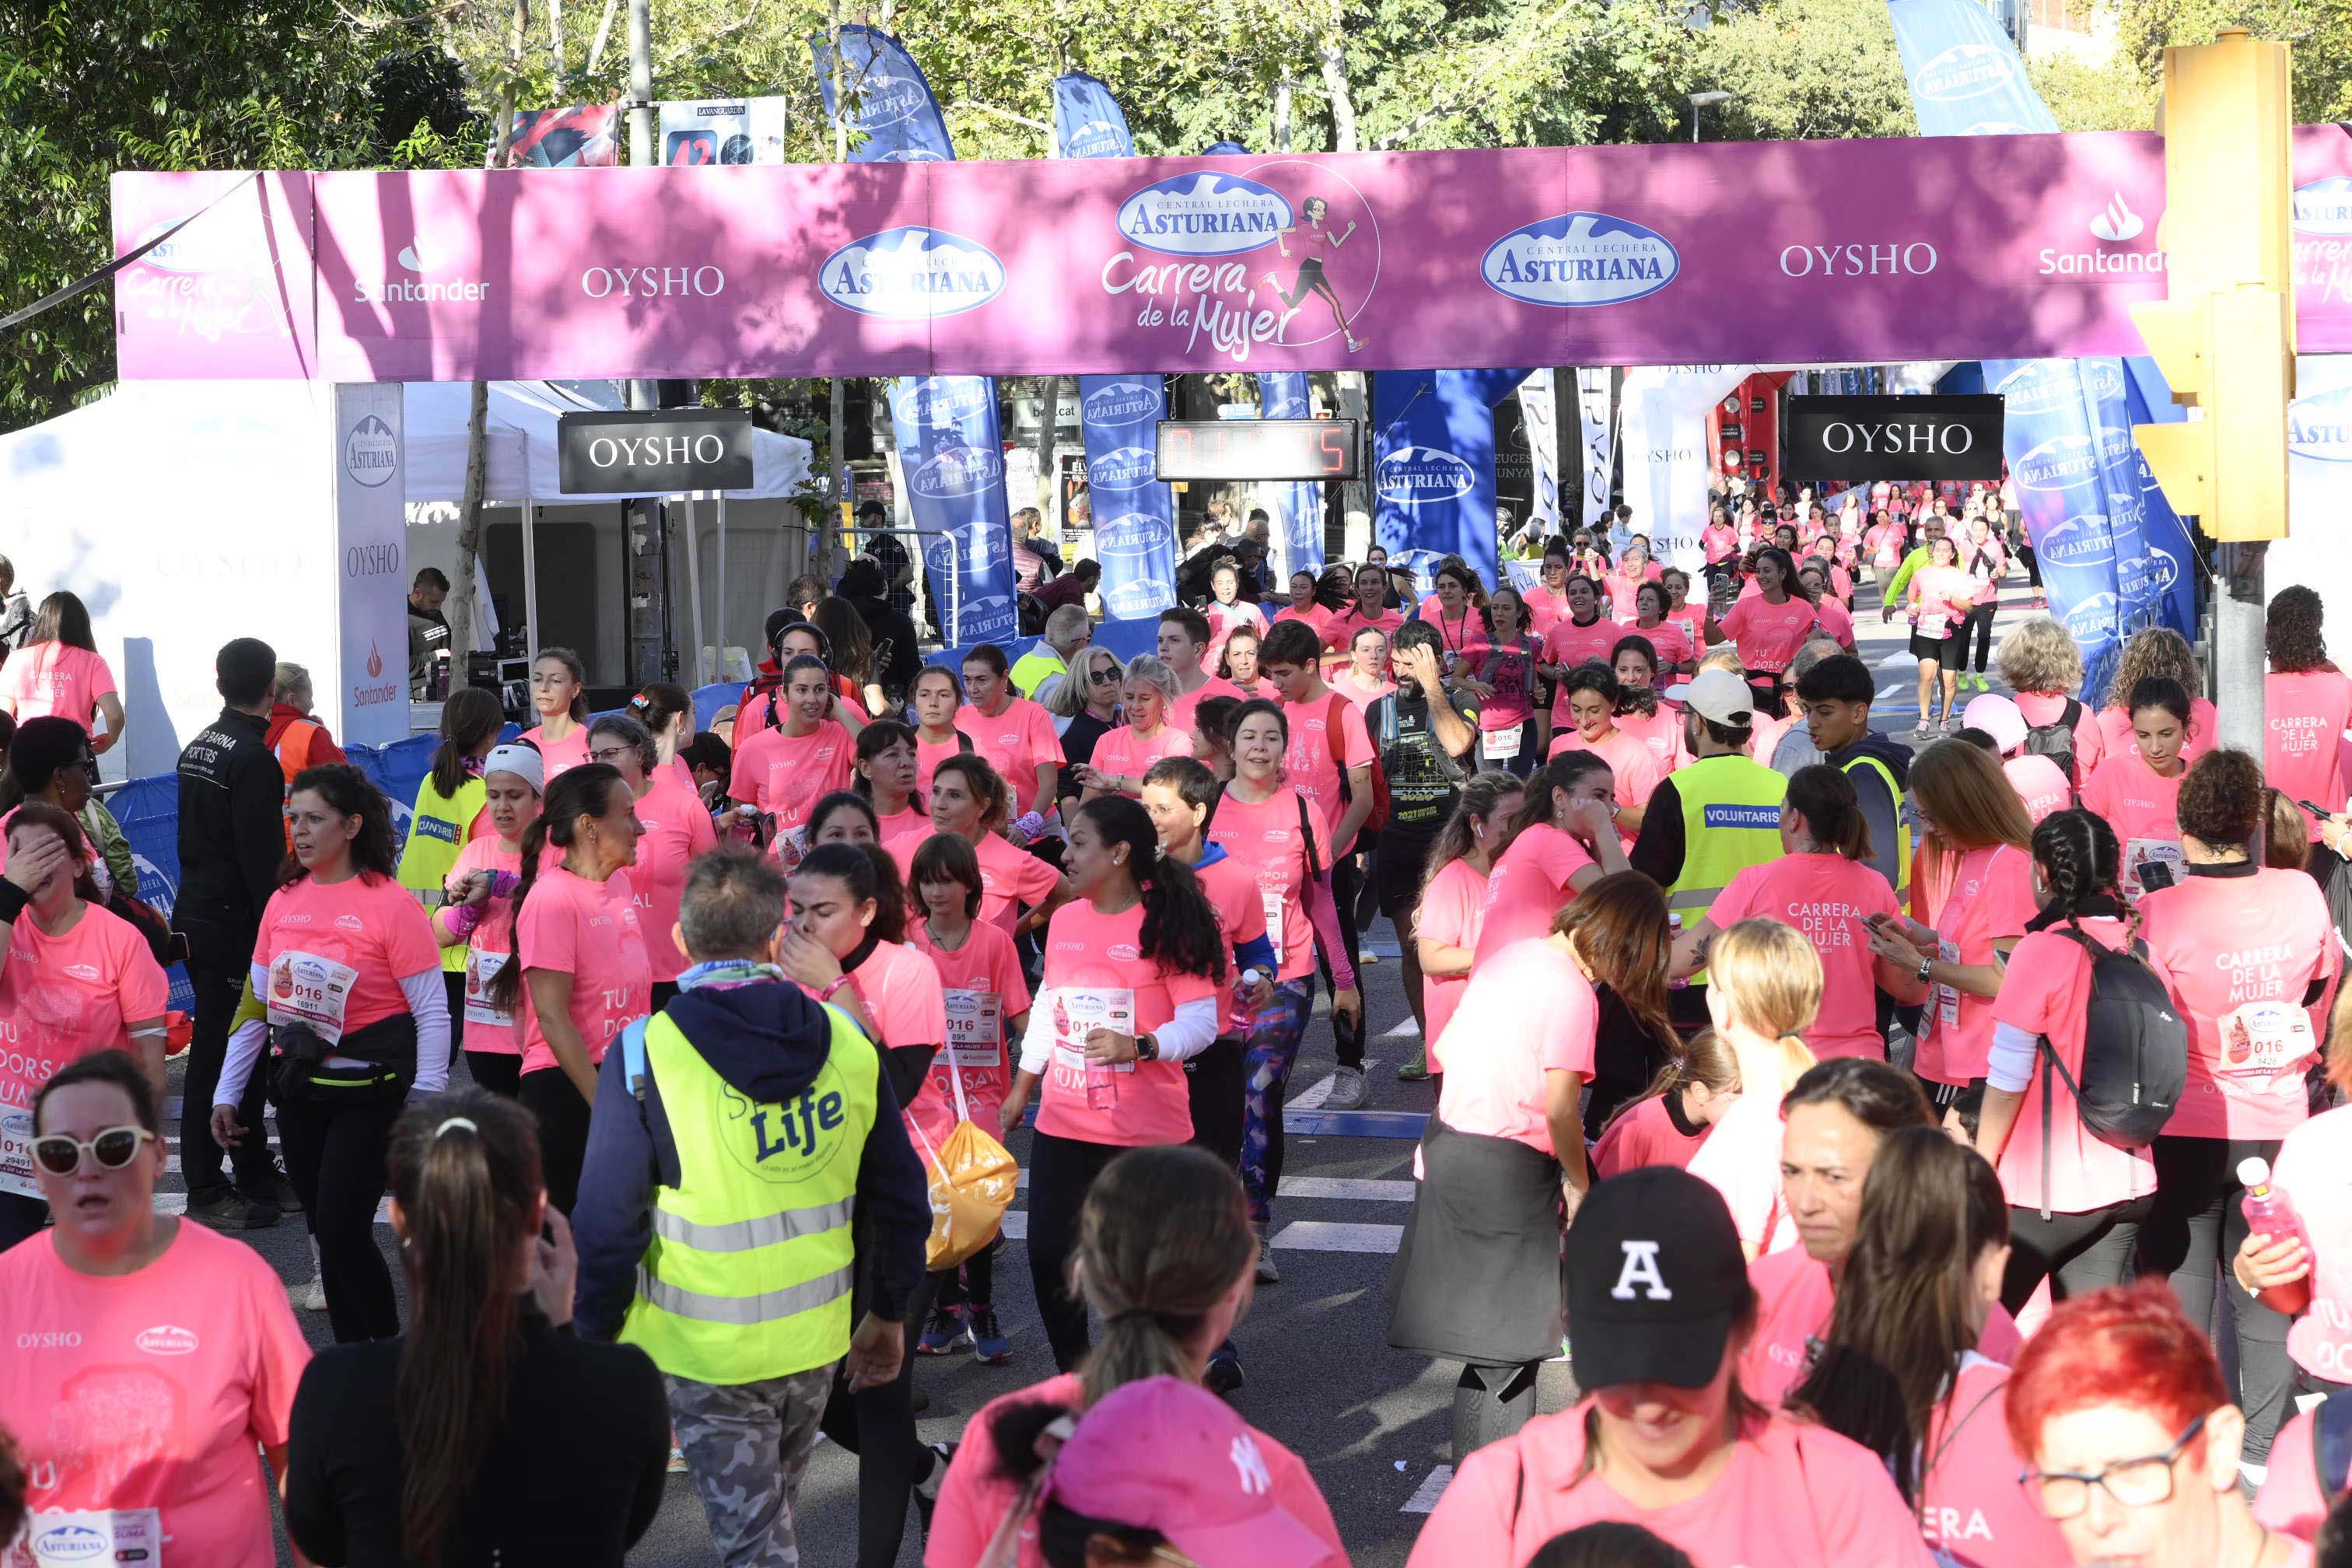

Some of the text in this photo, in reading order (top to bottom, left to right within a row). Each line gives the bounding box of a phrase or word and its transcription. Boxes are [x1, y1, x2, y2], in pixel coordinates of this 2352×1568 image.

[706, 106, 744, 116] VANGUARDIA
[1157, 199, 1275, 209] CENTRAL LECHERA
[1129, 203, 1279, 234] ASTURIANA
[1527, 243, 1657, 256] CENTRAL LECHERA
[1496, 249, 1664, 284] ASTURIANA
[1780, 243, 1938, 277] OYSHO
[833, 261, 992, 295] ASTRIANA
[1101, 251, 1247, 294] Carrera
[355, 277, 489, 303] Santander
[582, 265, 725, 299] OYSHO
[1137, 289, 1302, 362] de la Mujer
[1822, 422, 1972, 454] OYSHO
[350, 443, 394, 469] ASTURIANA
[589, 433, 724, 468] OYSHO
[1380, 470, 1468, 491] ASTURIANA
[347, 543, 399, 577] OYSHO
[1755, 649, 1767, 658] TU
[354, 681, 397, 708] Santander
[2270, 716, 2328, 731] CARRERA
[206, 731, 237, 751] BARNA
[2281, 728, 2316, 740] DE LA
[2280, 740, 2319, 753] MUJER
[768, 759, 796, 771] OYSHO
[779, 807, 798, 824] TU
[1706, 807, 1780, 824] VOLUNTARIS
[1264, 871, 1289, 880] POR
[1787, 902, 1861, 918] CARRERA
[280, 914, 312, 925] OYSHO
[1803, 918, 1849, 932] DE LA
[1055, 940, 1084, 952] OYSHO
[2215, 945, 2294, 970] CARRERA
[296, 966, 325, 980] ASTURIANA
[2232, 964, 2282, 985] DE LA
[295, 985, 323, 1001] 016
[603, 988, 628, 1010] TU
[2228, 979, 2284, 1003] MUJER
[297, 999, 318, 1010] 16911
[945, 1000, 978, 1010] ASTURIANA
[1069, 1001, 1104, 1010] ASTURIANA
[311, 1013, 330, 1023] MUJER
[947, 1019, 975, 1031] 016
[2254, 1040, 2284, 1055] 016
[750, 1086, 844, 1164] Life
[5, 1156, 30, 1167] 29491
[1612, 1239, 1673, 1300] A
[16, 1331, 82, 1349] OYSHO
[1920, 1507, 1993, 1540] ERA
[42, 1539, 103, 1552] ASTURIANA
